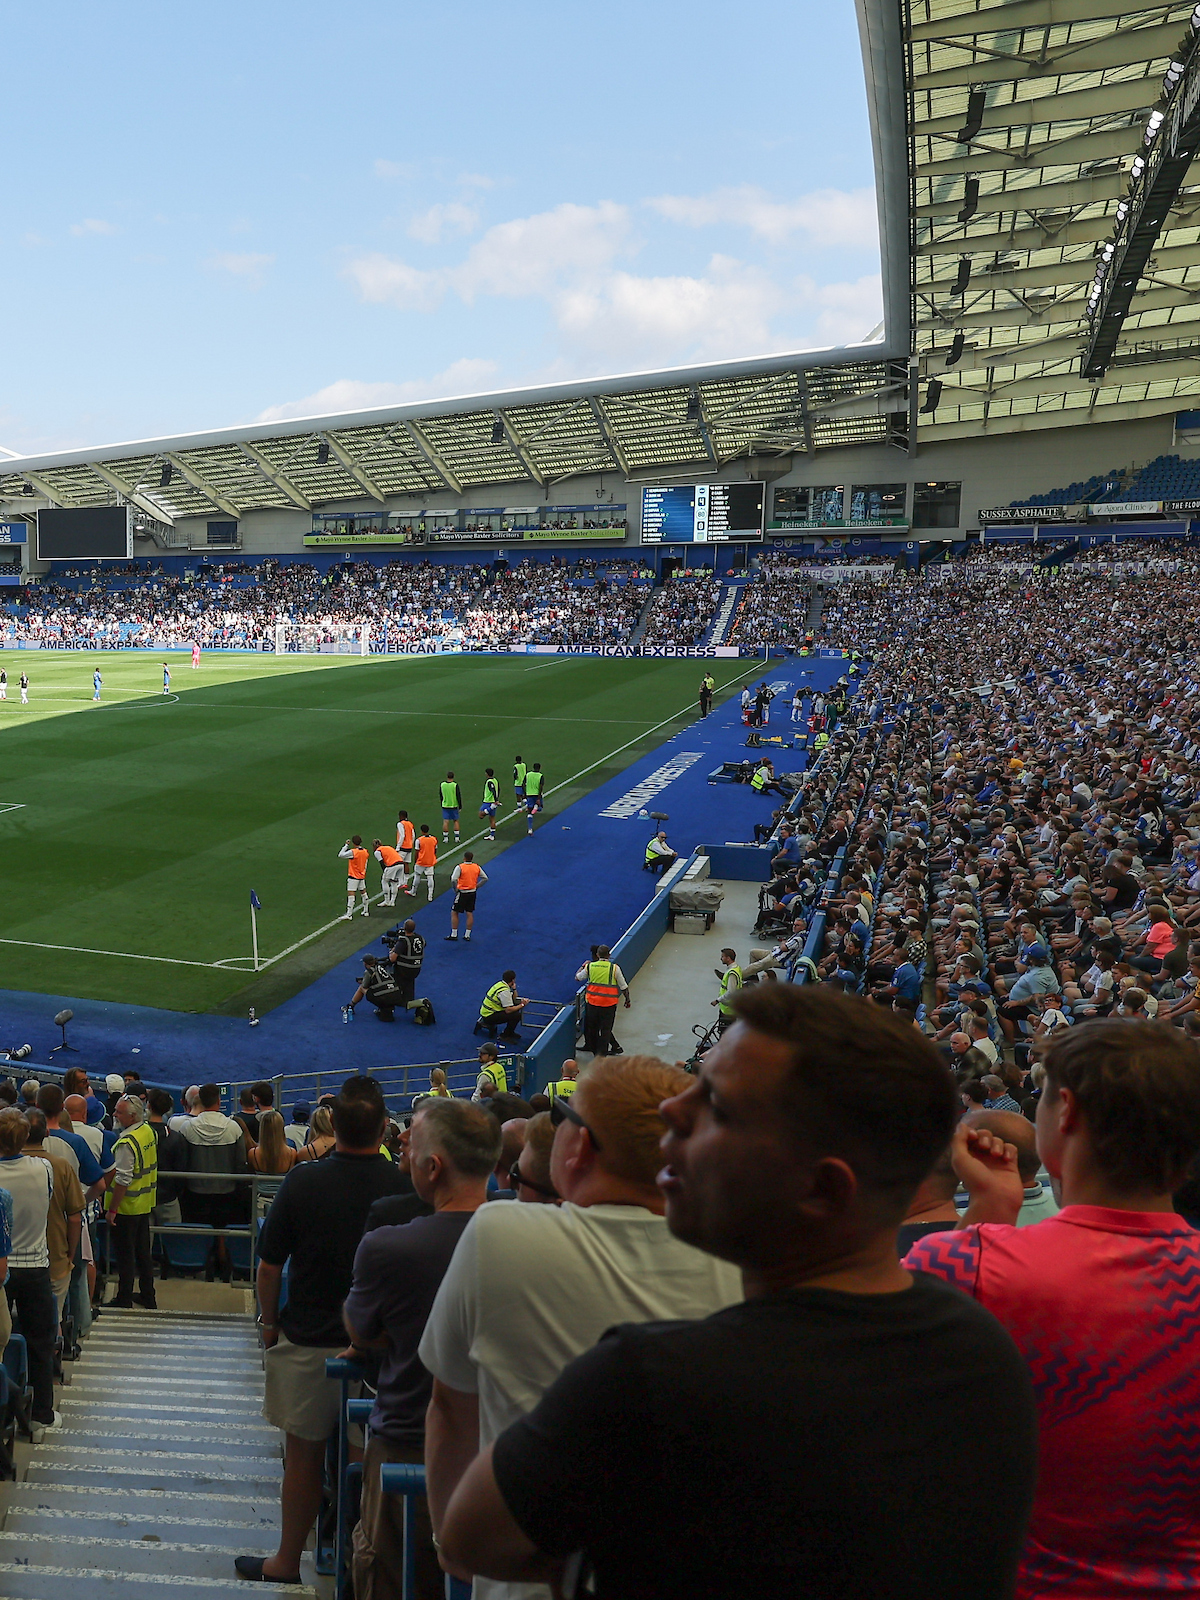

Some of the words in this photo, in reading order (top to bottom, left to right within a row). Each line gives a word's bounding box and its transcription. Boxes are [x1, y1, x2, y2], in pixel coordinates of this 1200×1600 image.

[1106, 483, 1113, 491] H
[1104, 504, 1124, 513] Agora
[1124, 502, 1146, 512] Clinic
[1172, 502, 1184, 510] THE
[980, 510, 1012, 519] SUSSEX
[907, 541, 914, 550] G
[1090, 537, 1096, 545] H
[39, 641, 97, 650] AMERICAN
[368, 644, 436, 654] AMERICAN
[556, 645, 636, 657] AMERICAN
[641, 646, 717, 657] EXPRESS
